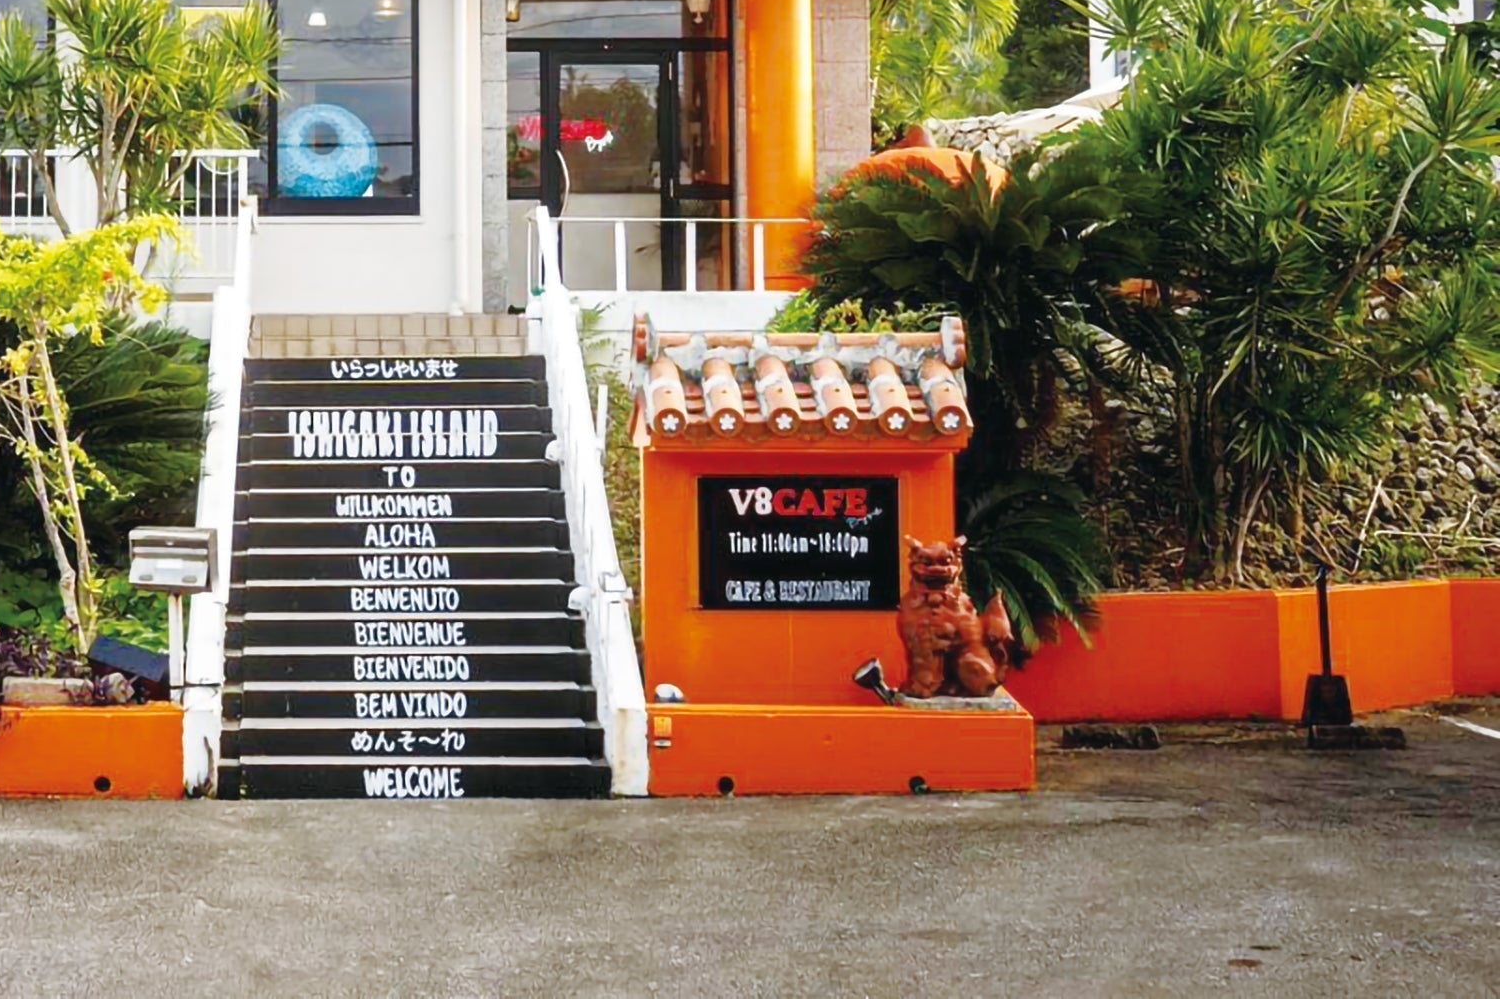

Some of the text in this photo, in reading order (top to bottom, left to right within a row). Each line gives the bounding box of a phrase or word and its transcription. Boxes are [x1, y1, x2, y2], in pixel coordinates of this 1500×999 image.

[288, 409, 498, 458] ISHIGAKI ISLAND
[381, 465, 416, 488] TO
[336, 494, 452, 517] WILLKOMMEN
[364, 522, 436, 548] ALOHA
[728, 531, 757, 553] Time
[358, 555, 450, 580] WELKOM
[350, 586, 460, 612] BENVENUTO
[725, 580, 762, 602] CAFE
[354, 621, 467, 646] BIENVENUE
[354, 691, 468, 718] BEM VINDO
[363, 767, 464, 798] WELCOME
